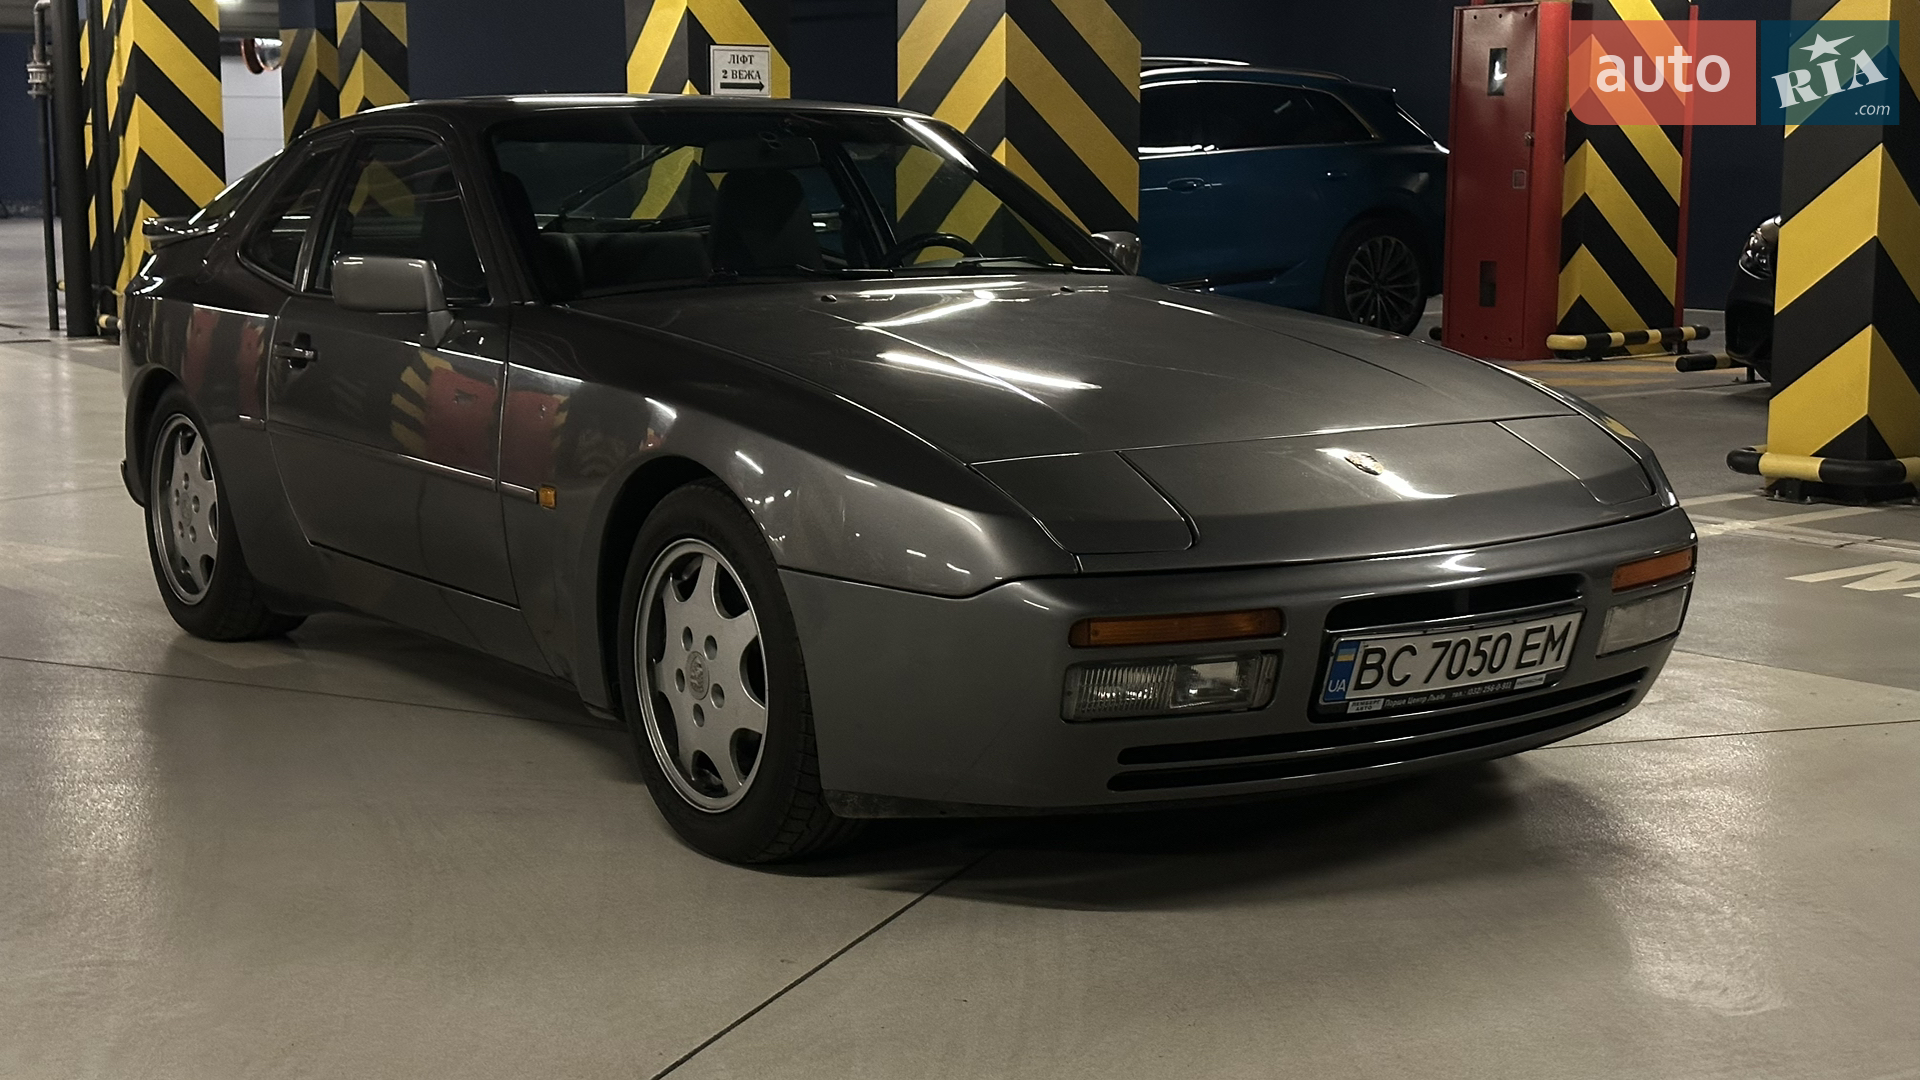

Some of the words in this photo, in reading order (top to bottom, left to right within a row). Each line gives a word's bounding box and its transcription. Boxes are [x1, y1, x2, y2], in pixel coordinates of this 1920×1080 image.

[728, 54, 755, 65] ЛІФТ
[721, 69, 728, 79] 2
[731, 69, 761, 80] ВЕЖА
[1353, 642, 1418, 691] BC
[1423, 631, 1513, 684] 7050
[1515, 620, 1573, 670] EM
[1328, 678, 1347, 693] UA
